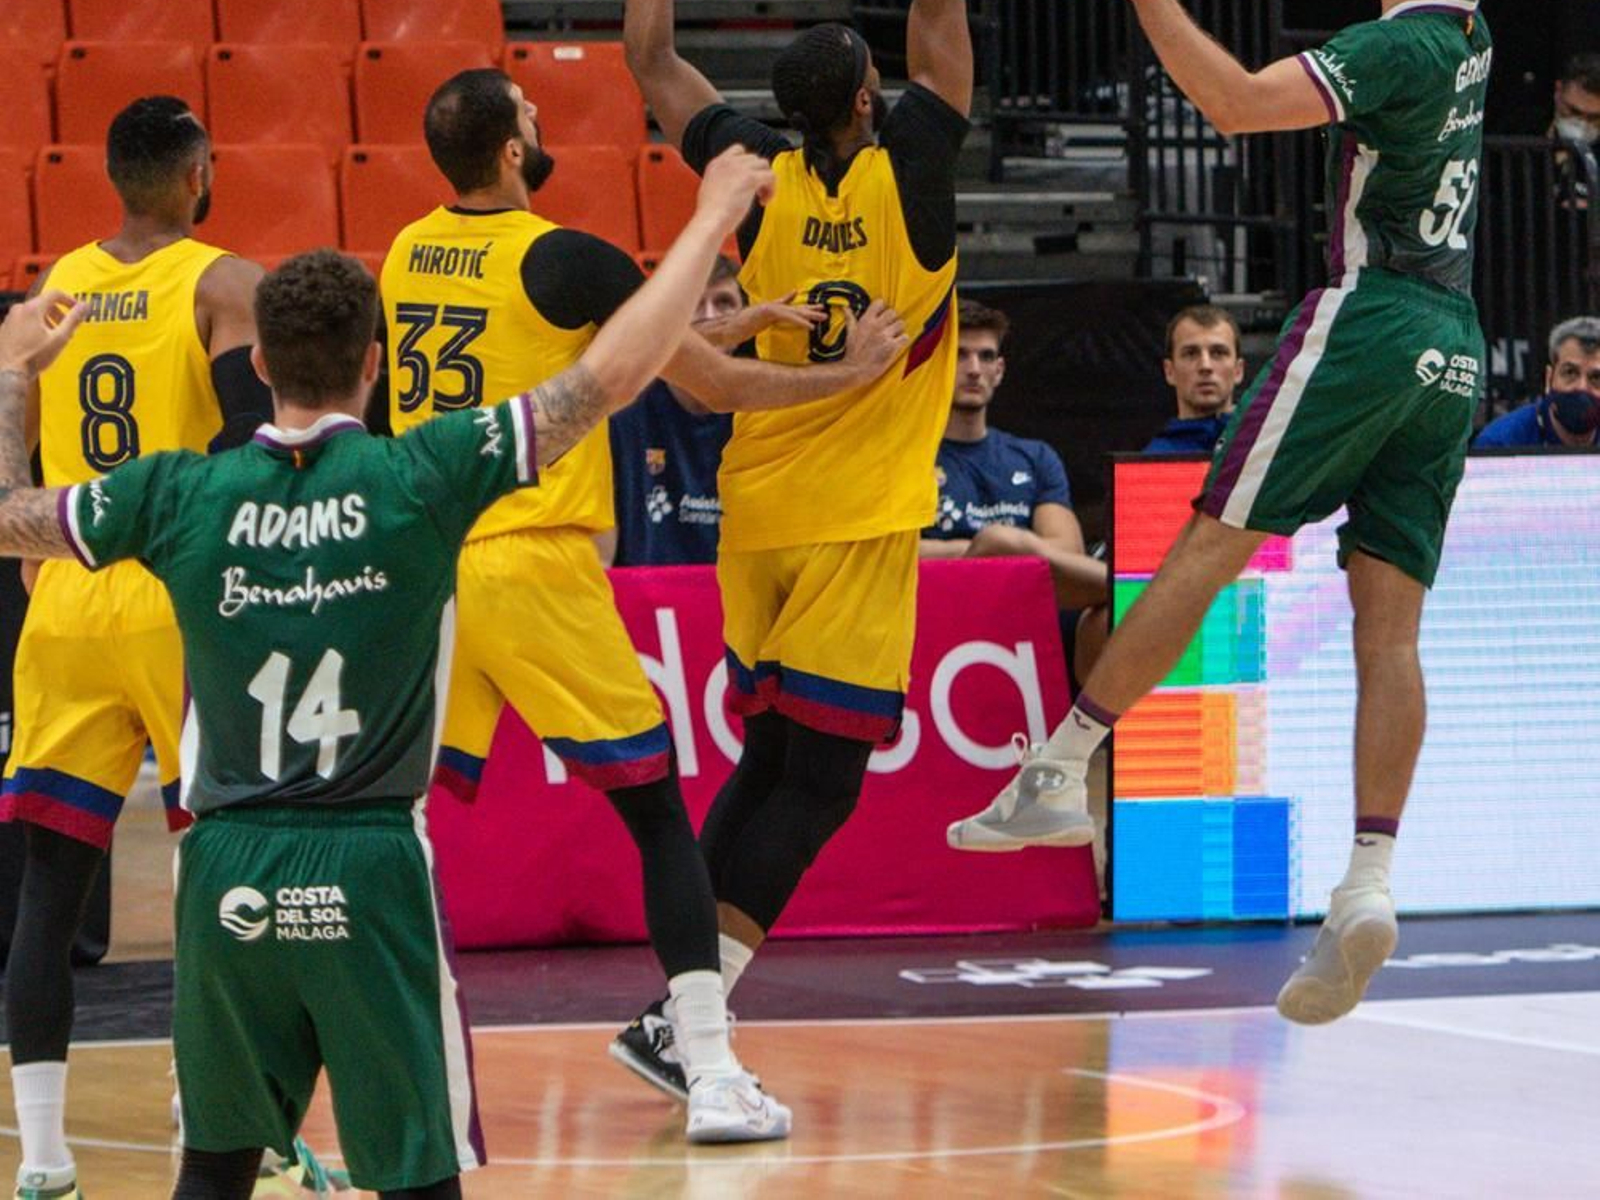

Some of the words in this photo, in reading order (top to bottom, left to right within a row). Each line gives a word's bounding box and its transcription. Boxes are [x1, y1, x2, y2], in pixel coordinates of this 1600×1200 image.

[1418, 158, 1478, 250] 52
[408, 240, 494, 280] MIROTIĆ
[395, 302, 490, 414] 33
[78, 352, 141, 475] 8
[226, 493, 368, 550] ADAMS
[246, 647, 361, 783] 14
[275, 885, 348, 907] COSTA
[275, 907, 309, 924] DEL
[309, 906, 349, 923] SOL
